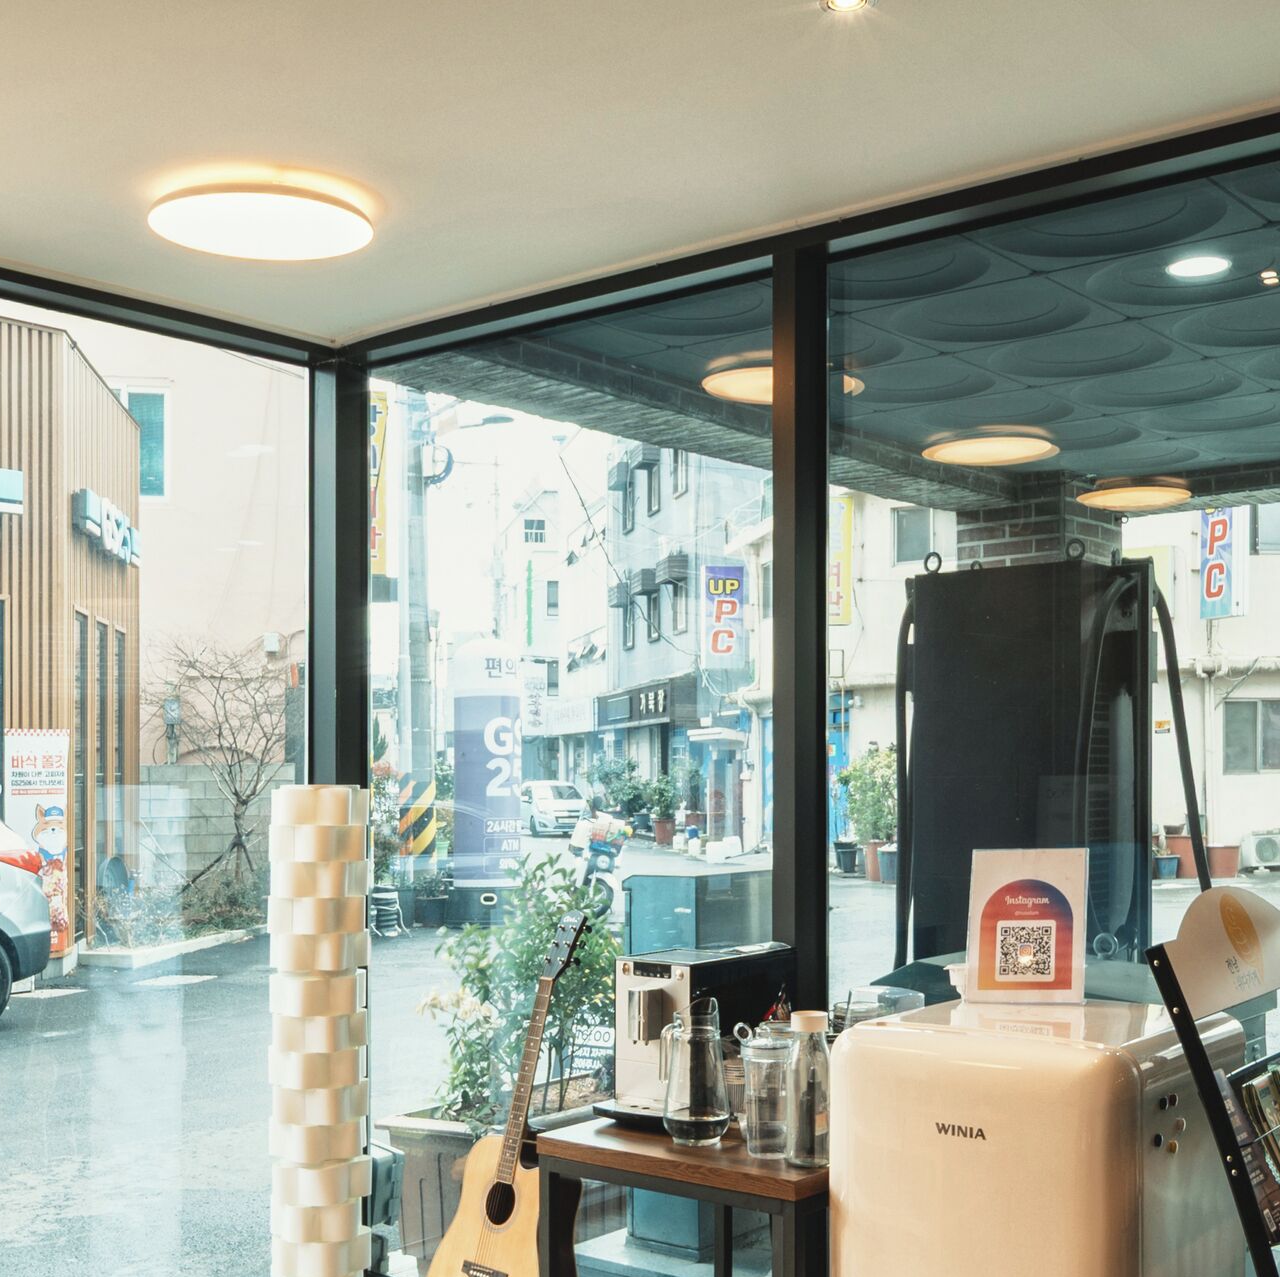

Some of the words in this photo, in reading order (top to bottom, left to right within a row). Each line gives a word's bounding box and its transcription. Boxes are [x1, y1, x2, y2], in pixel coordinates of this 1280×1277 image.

[709, 578, 739, 595] UP
[1004, 895, 1051, 908] Instagram
[935, 1122, 987, 1141] WINIA
